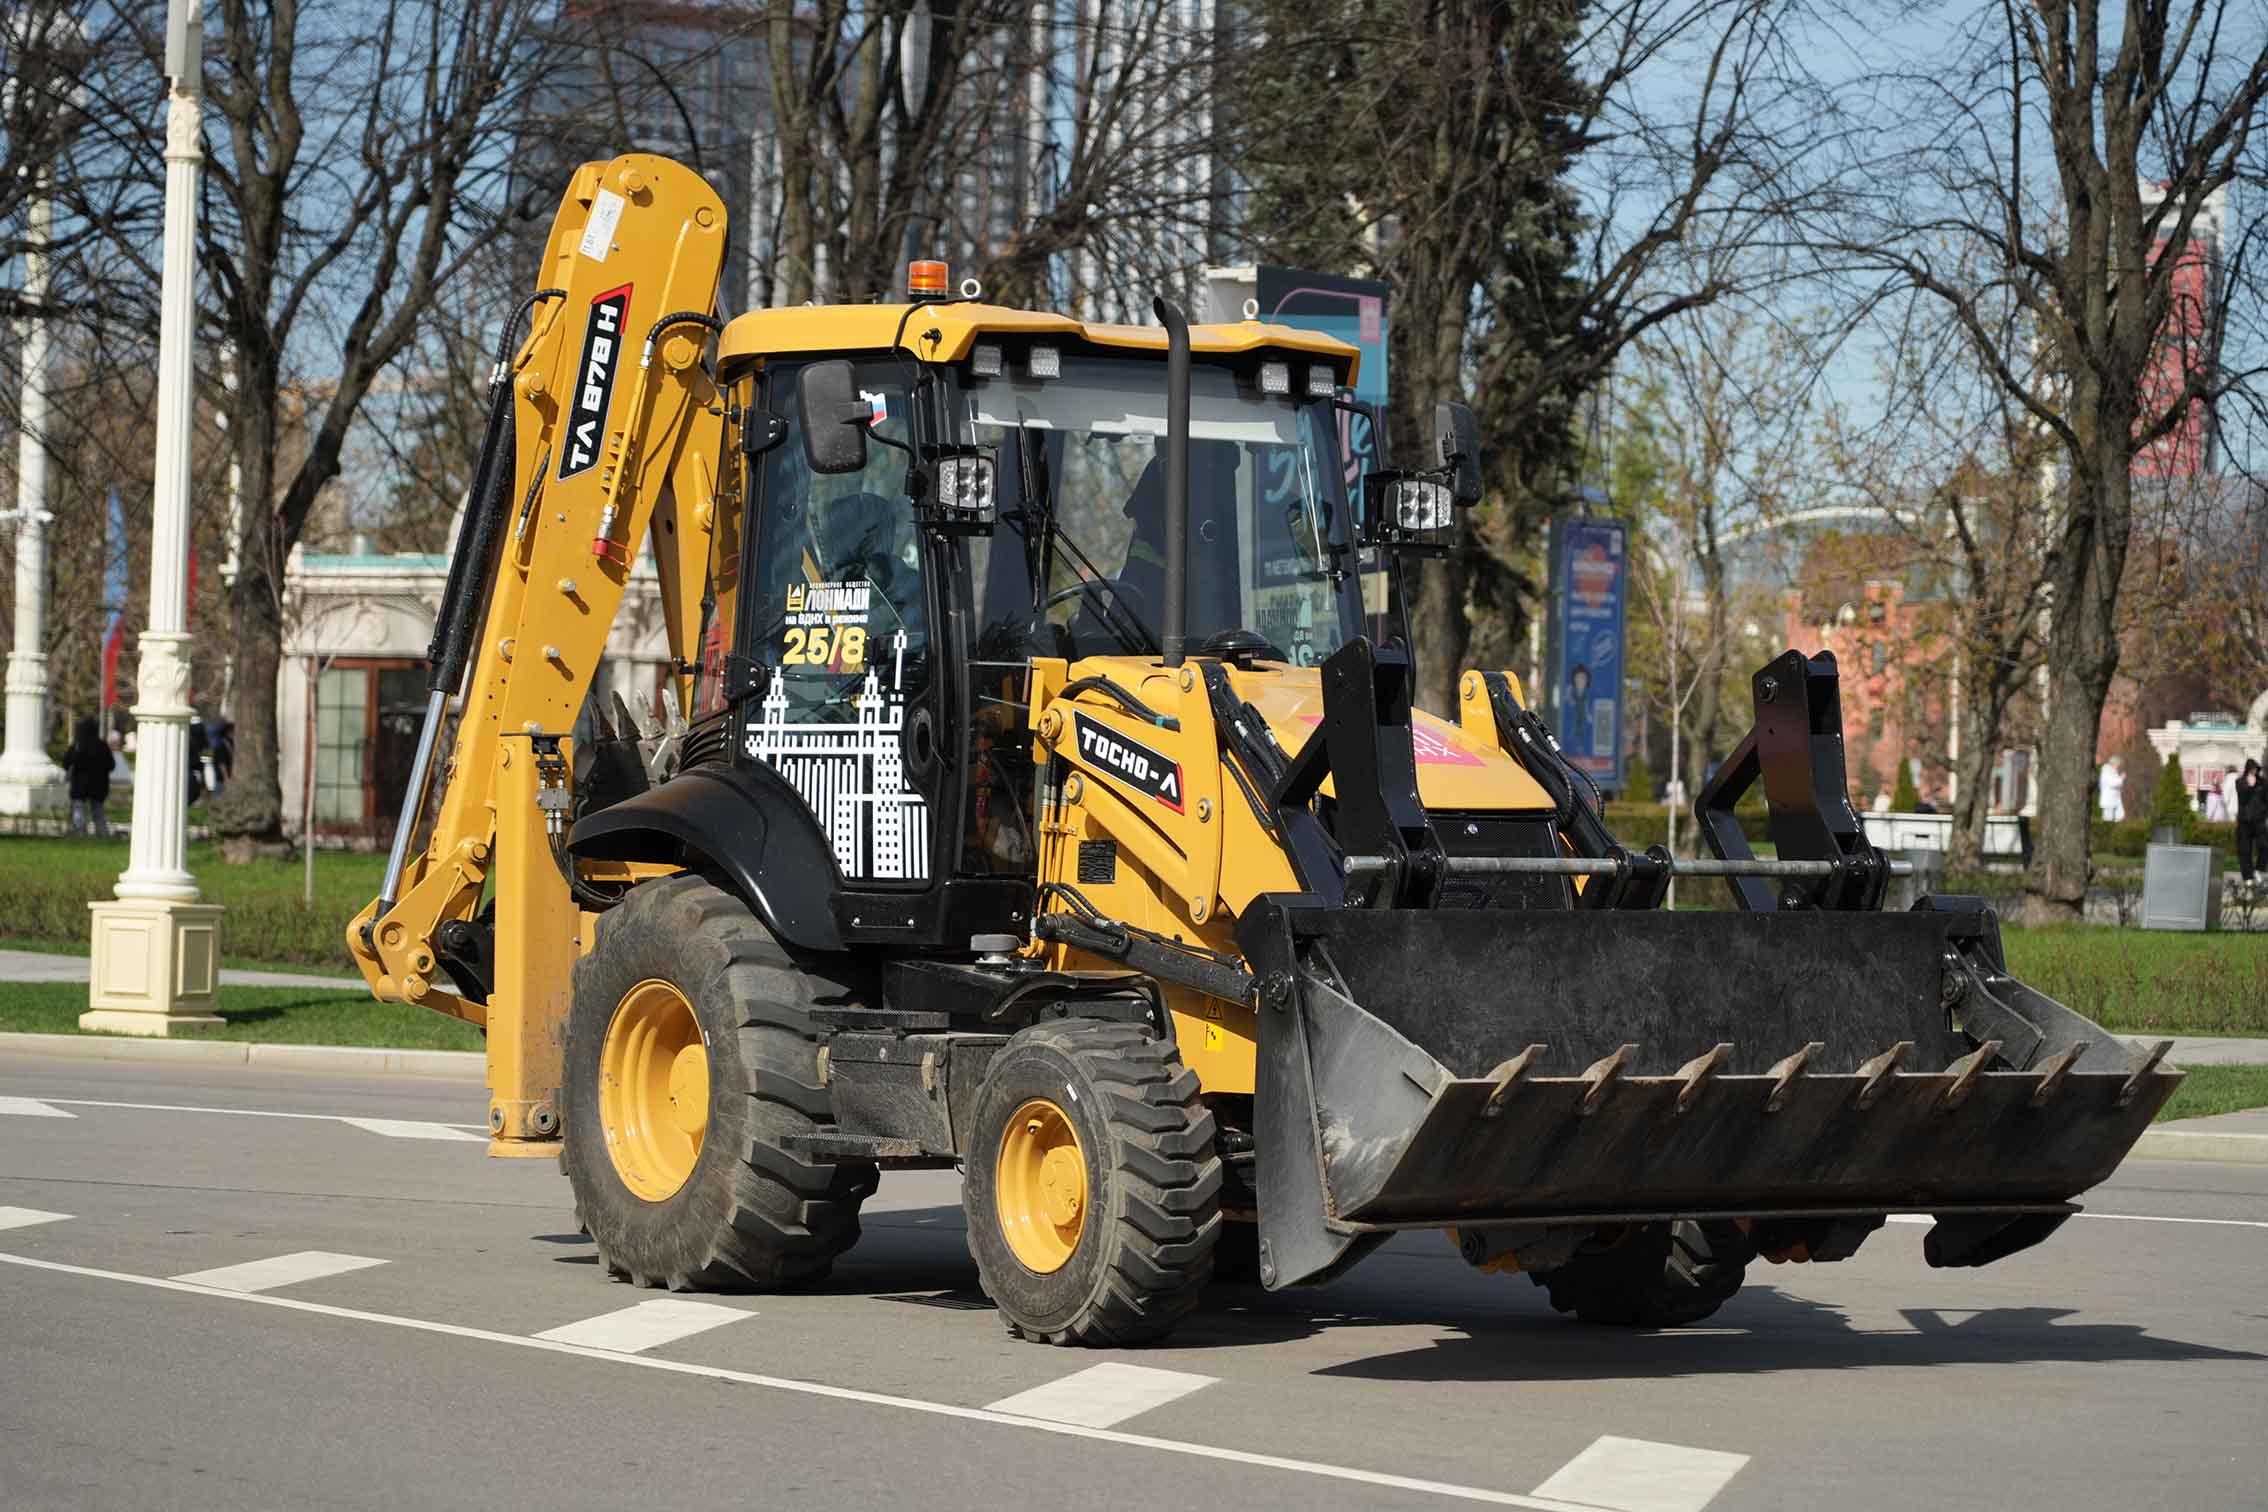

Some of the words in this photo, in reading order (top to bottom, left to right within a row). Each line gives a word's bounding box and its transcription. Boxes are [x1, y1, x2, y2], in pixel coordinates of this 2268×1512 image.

[804, 588, 870, 611] ЛОНМАДИ
[785, 615, 797, 625] на
[798, 613, 824, 626] ВДНХ
[832, 614, 869, 625] режиме
[782, 626, 866, 665] 25/8
